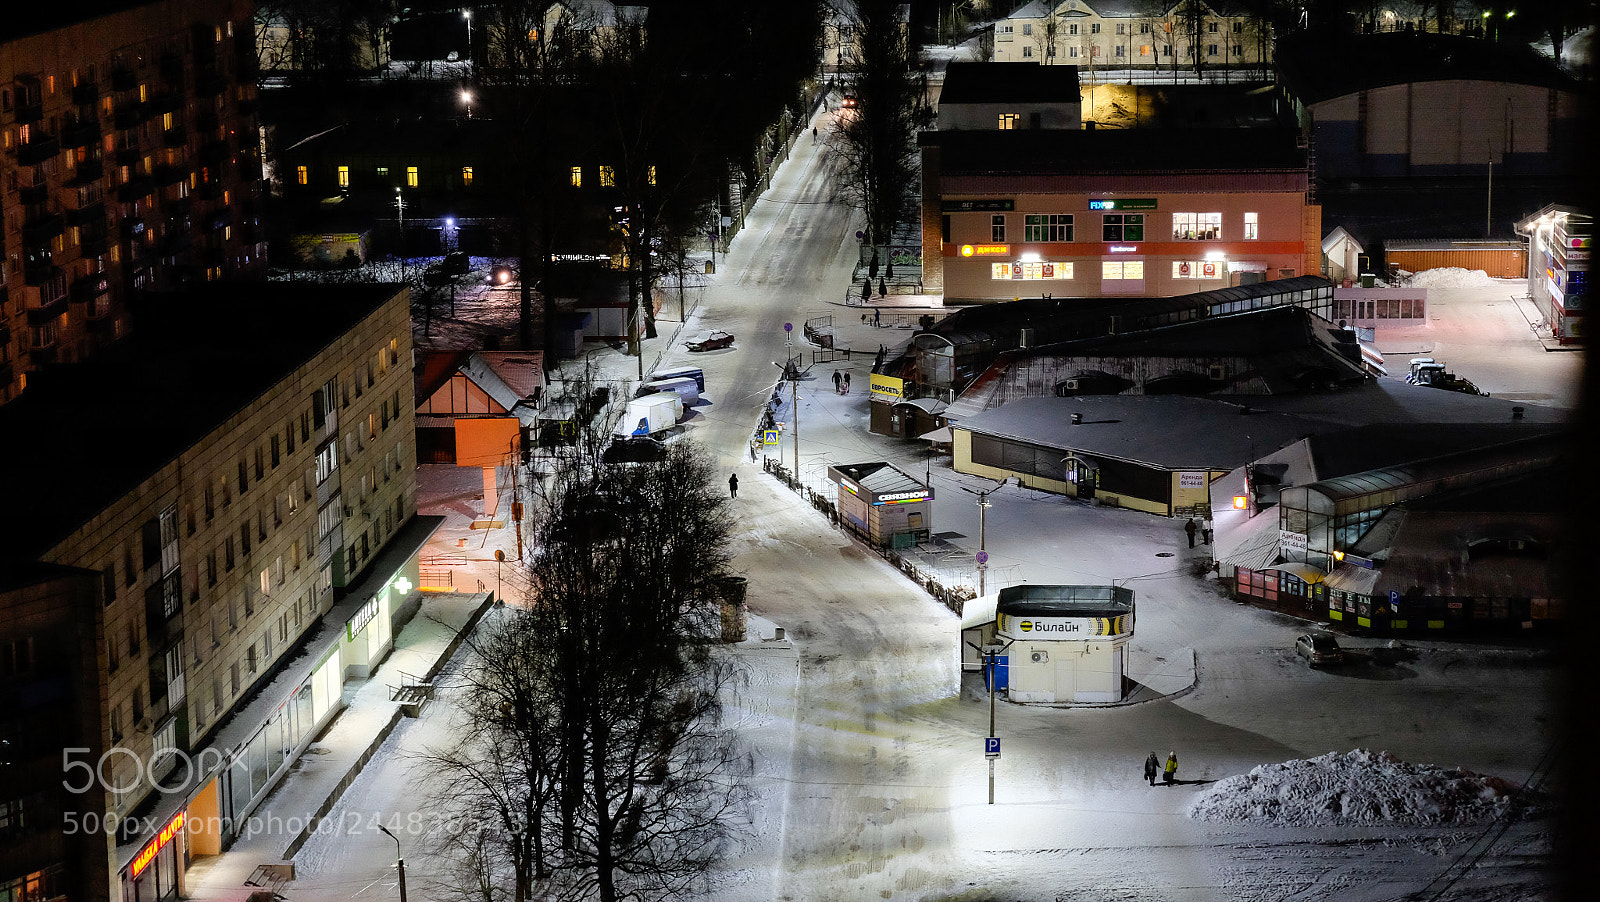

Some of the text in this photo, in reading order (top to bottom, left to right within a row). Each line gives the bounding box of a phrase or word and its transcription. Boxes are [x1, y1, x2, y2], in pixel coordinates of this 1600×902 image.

[976, 246, 1007, 254] ДИКСИ
[871, 384, 900, 394] ЕВРОСЕТЬ
[878, 490, 929, 501] СВЯЗНОЙ
[1034, 621, 1079, 633] Билайн
